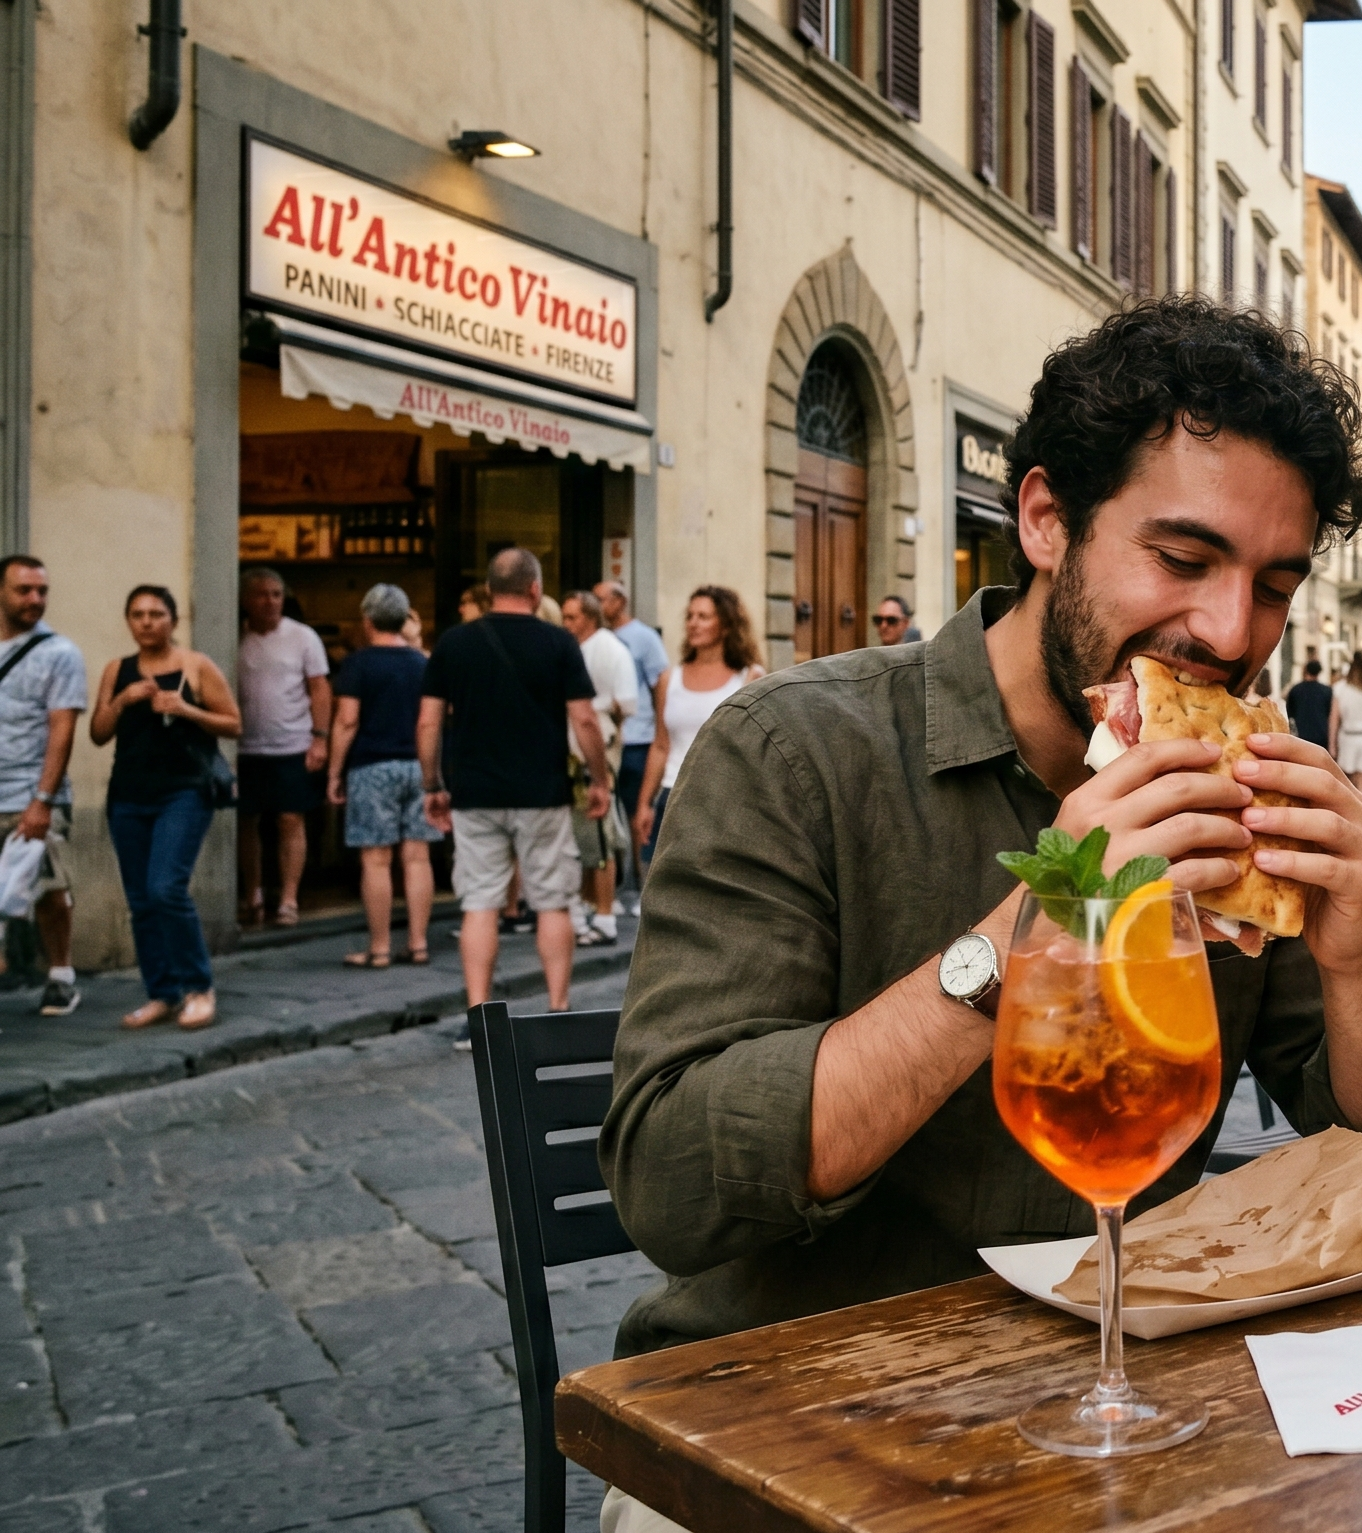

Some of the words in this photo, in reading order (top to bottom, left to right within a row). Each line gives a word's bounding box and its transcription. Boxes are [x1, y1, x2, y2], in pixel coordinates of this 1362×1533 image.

[263, 185, 501, 308] All'Antico
[509, 265, 627, 349] Vinaio
[285, 263, 367, 311] PANINI
[394, 296, 525, 358] SCHIACCIATE
[545, 343, 614, 383] FIRENZE
[399, 382, 505, 429] All'Antico
